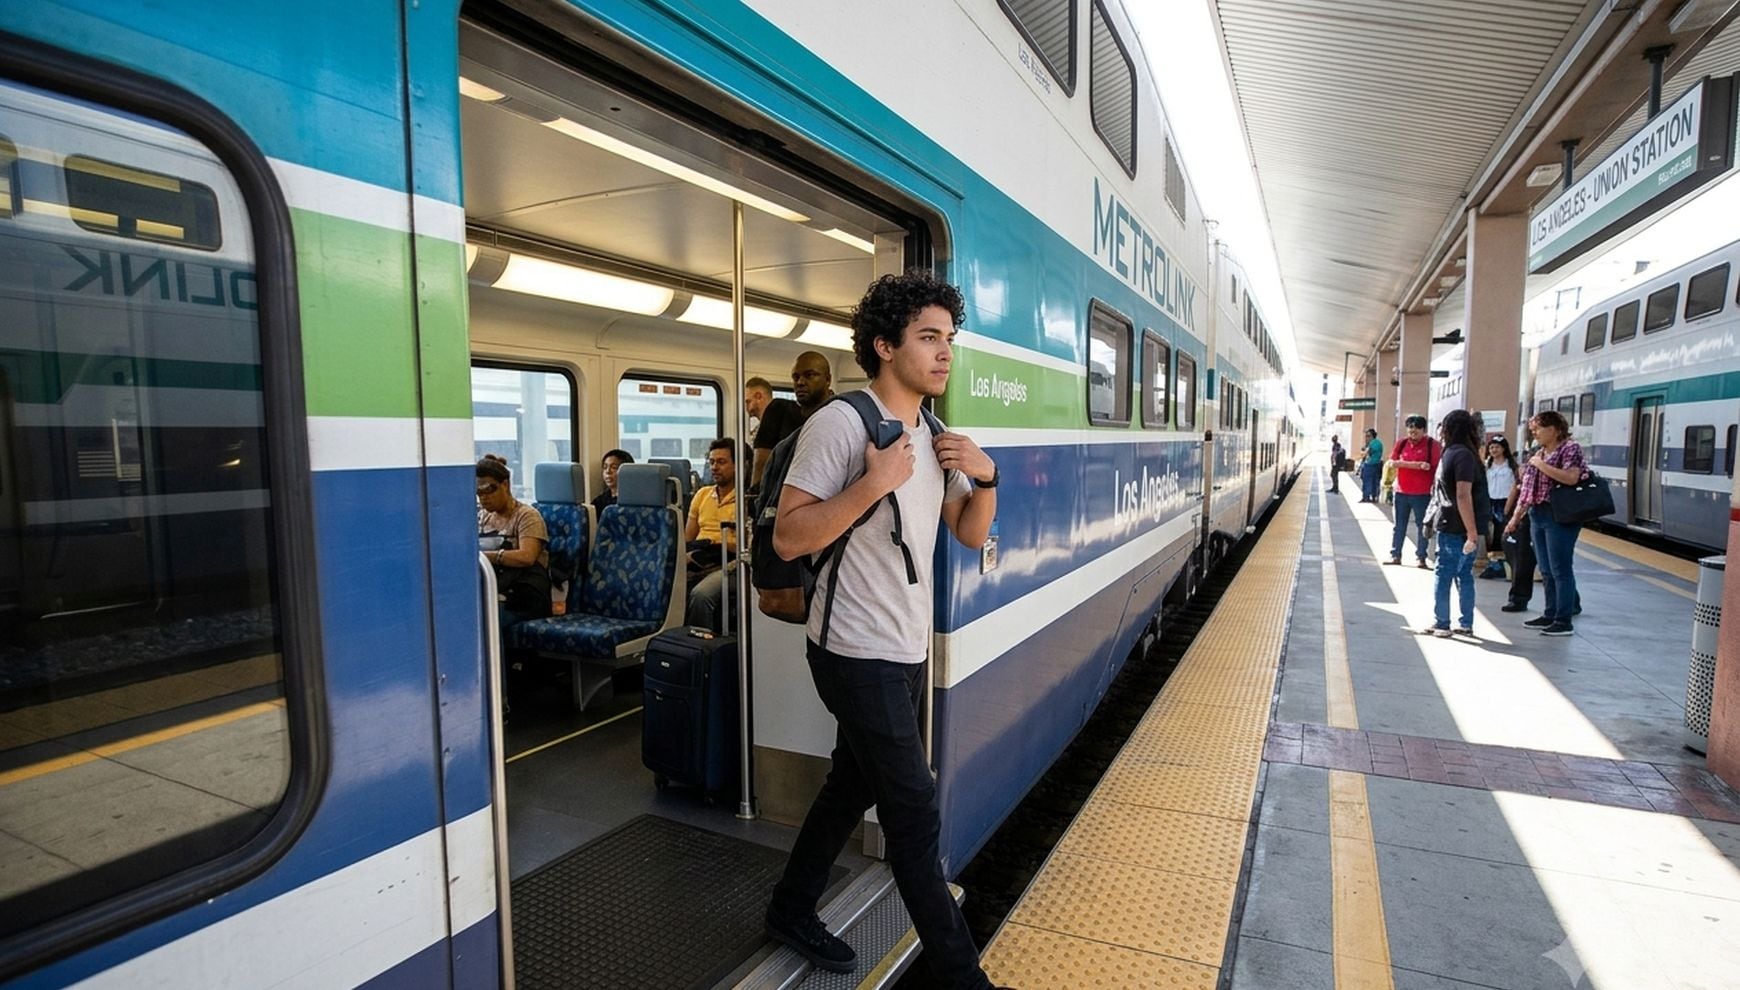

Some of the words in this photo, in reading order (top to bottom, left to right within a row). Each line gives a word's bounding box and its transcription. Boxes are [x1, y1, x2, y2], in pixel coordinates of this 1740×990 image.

[1593, 153, 1630, 202] UNION
[1632, 102, 1693, 175] STATION
[1094, 176, 1196, 331] METROLINK
[1114, 469, 1138, 526] Los
